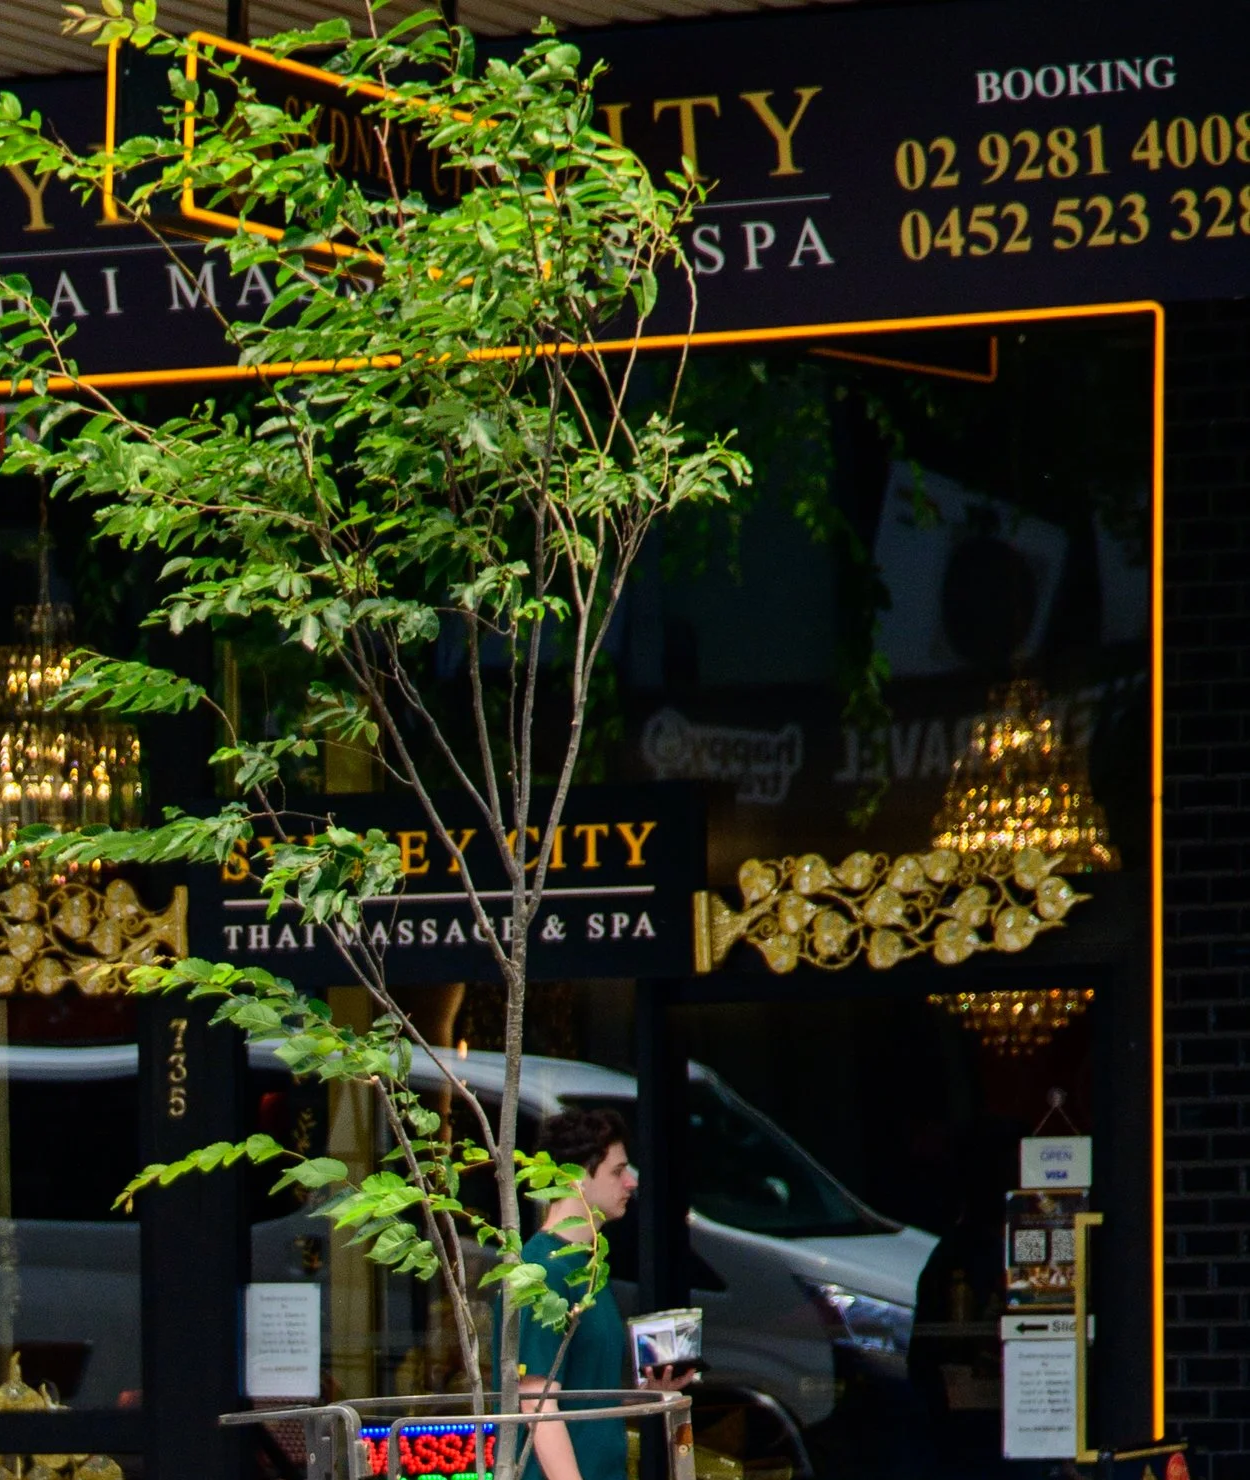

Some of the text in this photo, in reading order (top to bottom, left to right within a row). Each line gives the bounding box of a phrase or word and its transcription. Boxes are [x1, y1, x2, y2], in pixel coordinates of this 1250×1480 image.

[975, 54, 1178, 104] BOOKING
[894, 136, 962, 192] 02
[977, 122, 1113, 185] 9281
[690, 214, 836, 277] SPA
[900, 201, 1033, 262] 0452
[1051, 190, 1151, 250] 523
[222, 821, 658, 882] SEY CITY
[223, 922, 316, 951] THAI
[541, 914, 566, 942] &
[586, 910, 657, 940] SPA
[168, 1018, 188, 1118] 735
[1040, 1150, 1073, 1162] OPEN
[1044, 1169, 1068, 1180] VISA
